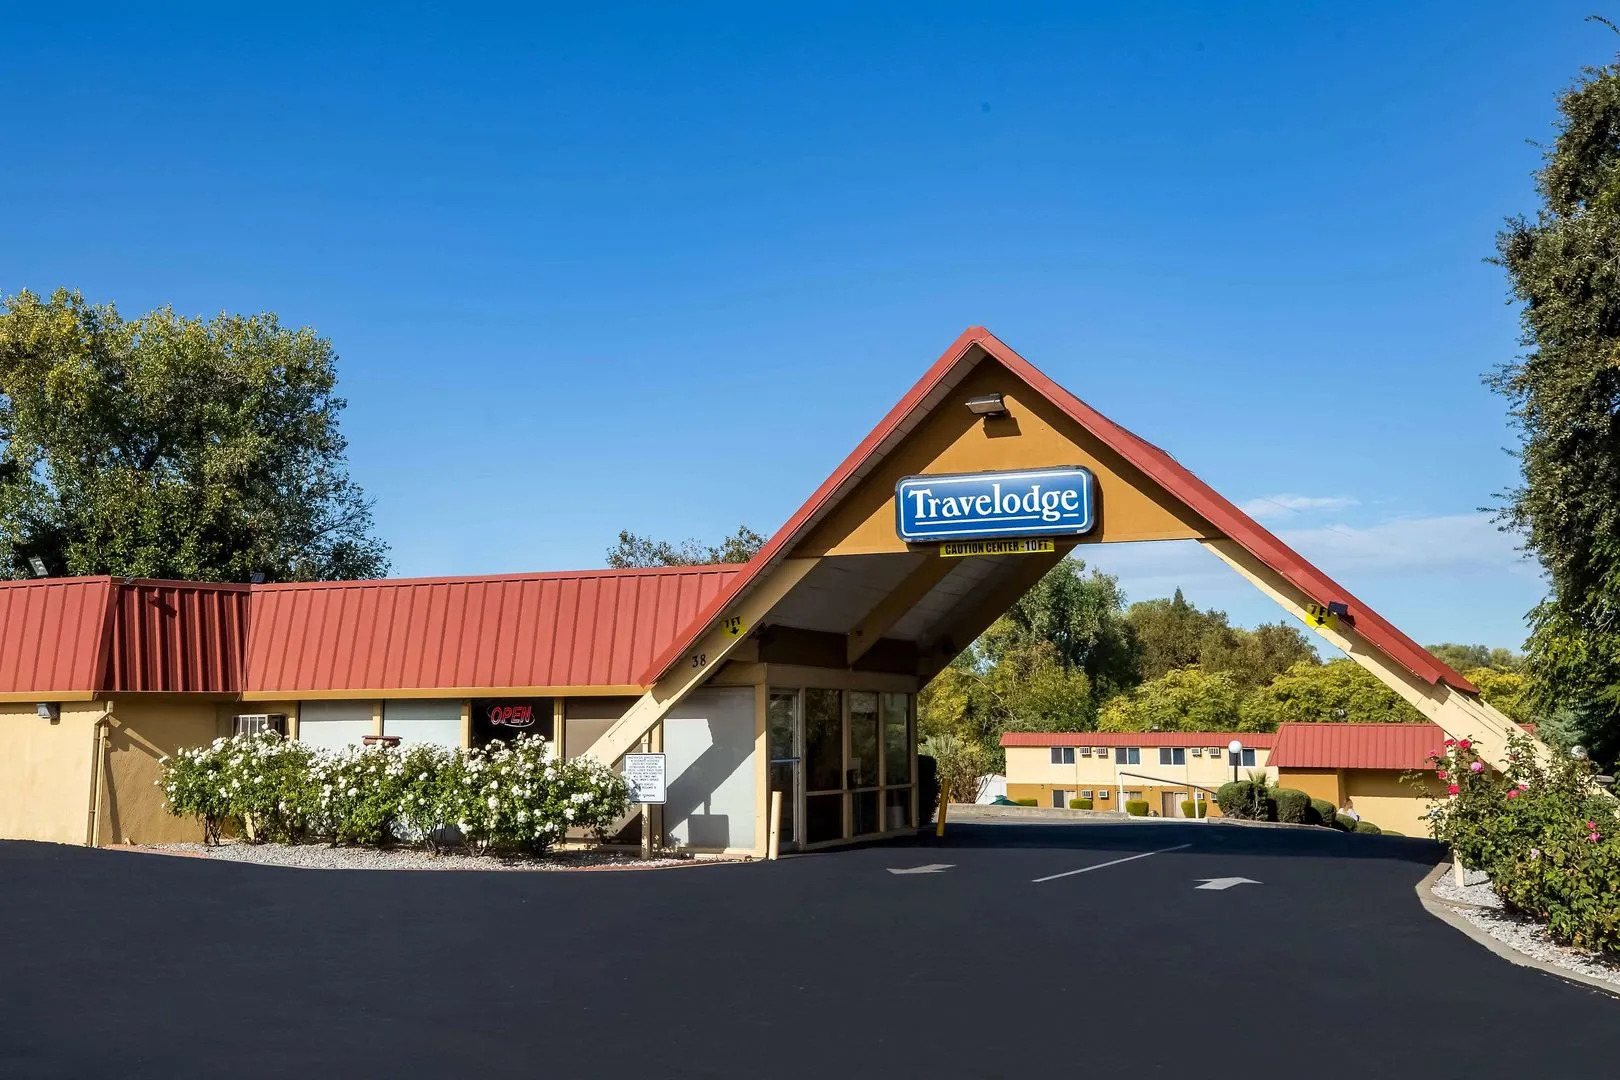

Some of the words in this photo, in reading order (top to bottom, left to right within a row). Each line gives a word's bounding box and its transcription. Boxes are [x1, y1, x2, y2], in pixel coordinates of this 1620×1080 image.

[908, 484, 1078, 521] Travelodge
[945, 543, 984, 554] CAUTION
[986, 541, 1019, 552] CENTER
[1038, 540, 1049, 550] FT
[731, 616, 740, 626] FT
[692, 654, 706, 668] 38
[490, 706, 532, 725] OPEN
